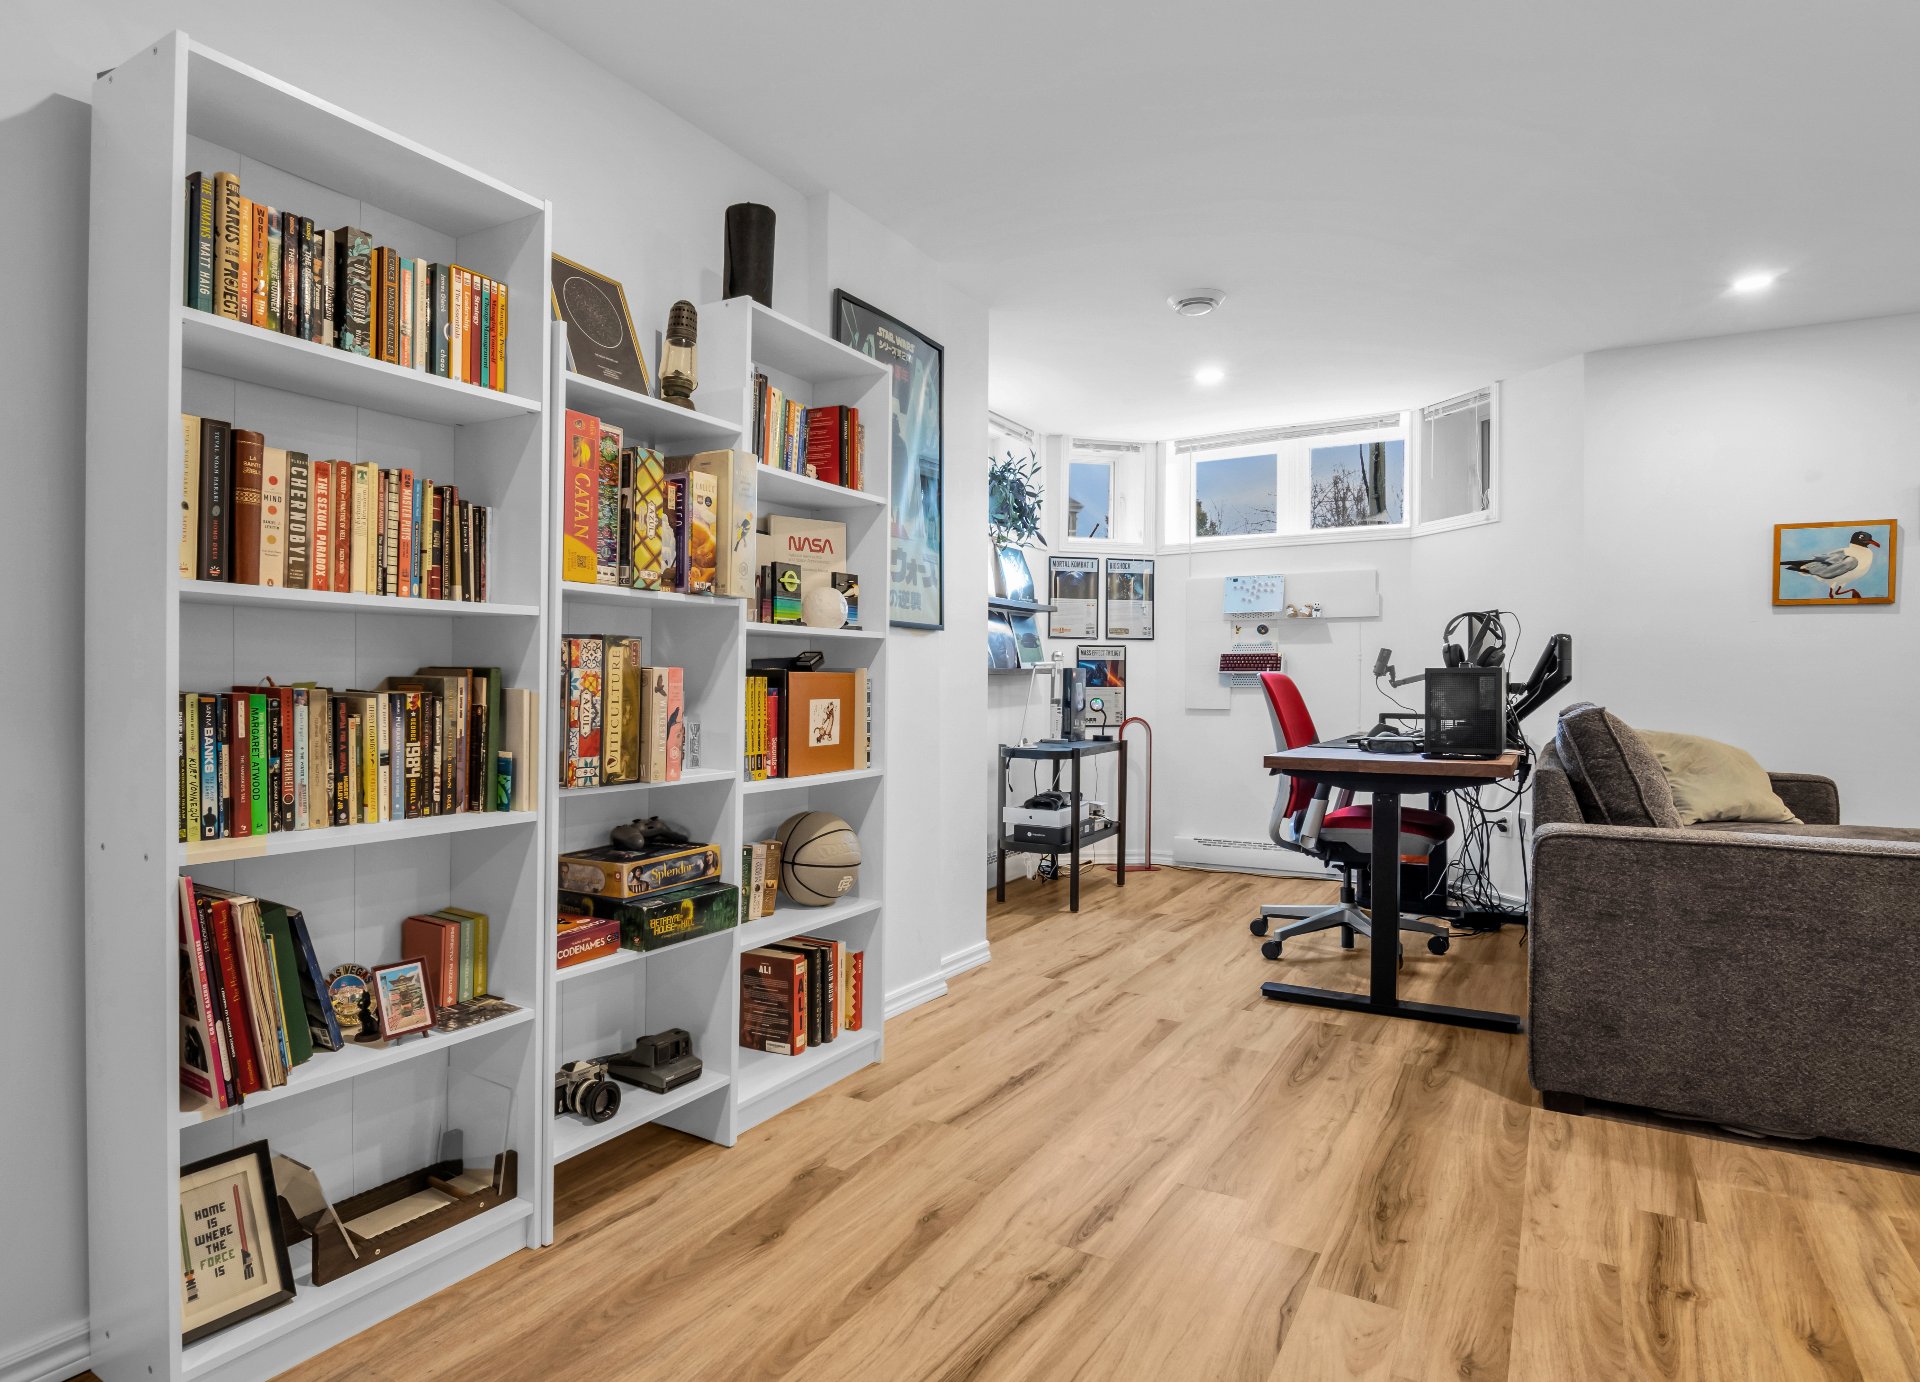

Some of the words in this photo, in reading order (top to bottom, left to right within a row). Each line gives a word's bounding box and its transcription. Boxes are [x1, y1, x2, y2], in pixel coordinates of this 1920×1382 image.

[201, 177, 212, 196] THE
[201, 197, 212, 239] HUMANS
[225, 181, 240, 245] LAZARUS
[200, 241, 211, 269] MATT
[200, 273, 210, 295] HAIG
[223, 259, 239, 319] PROJECT
[263, 494, 282, 503] MIND
[318, 477, 328, 495] THE
[289, 466, 308, 565] CHERNOBYL
[317, 497, 327, 532] SEXUAL
[402, 488, 412, 518] MASTER
[574, 473, 591, 539] CATAN
[401, 519, 411, 540] PLOTS
[315, 534, 327, 576] PARADOX
[788, 536, 834, 554] NASA
[1052, 560, 1070, 568] MORTAL
[582, 697, 590, 726] AZUL
[607, 650, 622, 768] VITICULTURE
[251, 708, 259, 758] MARGARET
[659, 700, 667, 752] WINGSPAN
[204, 727, 214, 773] BANKS
[405, 741, 421, 778] 1984
[188, 758, 198, 778] KURT
[284, 749, 293, 792] FAHRENHEIT
[252, 762, 260, 800] ATWOOD
[189, 781, 198, 822] VONNEGUT
[651, 862, 693, 885] Splendor
[557, 937, 605, 960] CODENAMES
[325, 967, 342, 986] LAS
[343, 965, 373, 983] VEGAS
[759, 965, 771, 974] ALI
[194, 1202, 226, 1221] HOME
[207, 1217, 217, 1229] IS
[195, 1224, 233, 1246] WHERE
[206, 1240, 227, 1254] THE
[200, 1249, 235, 1270] FORCE
[215, 1265, 225, 1278] IS
